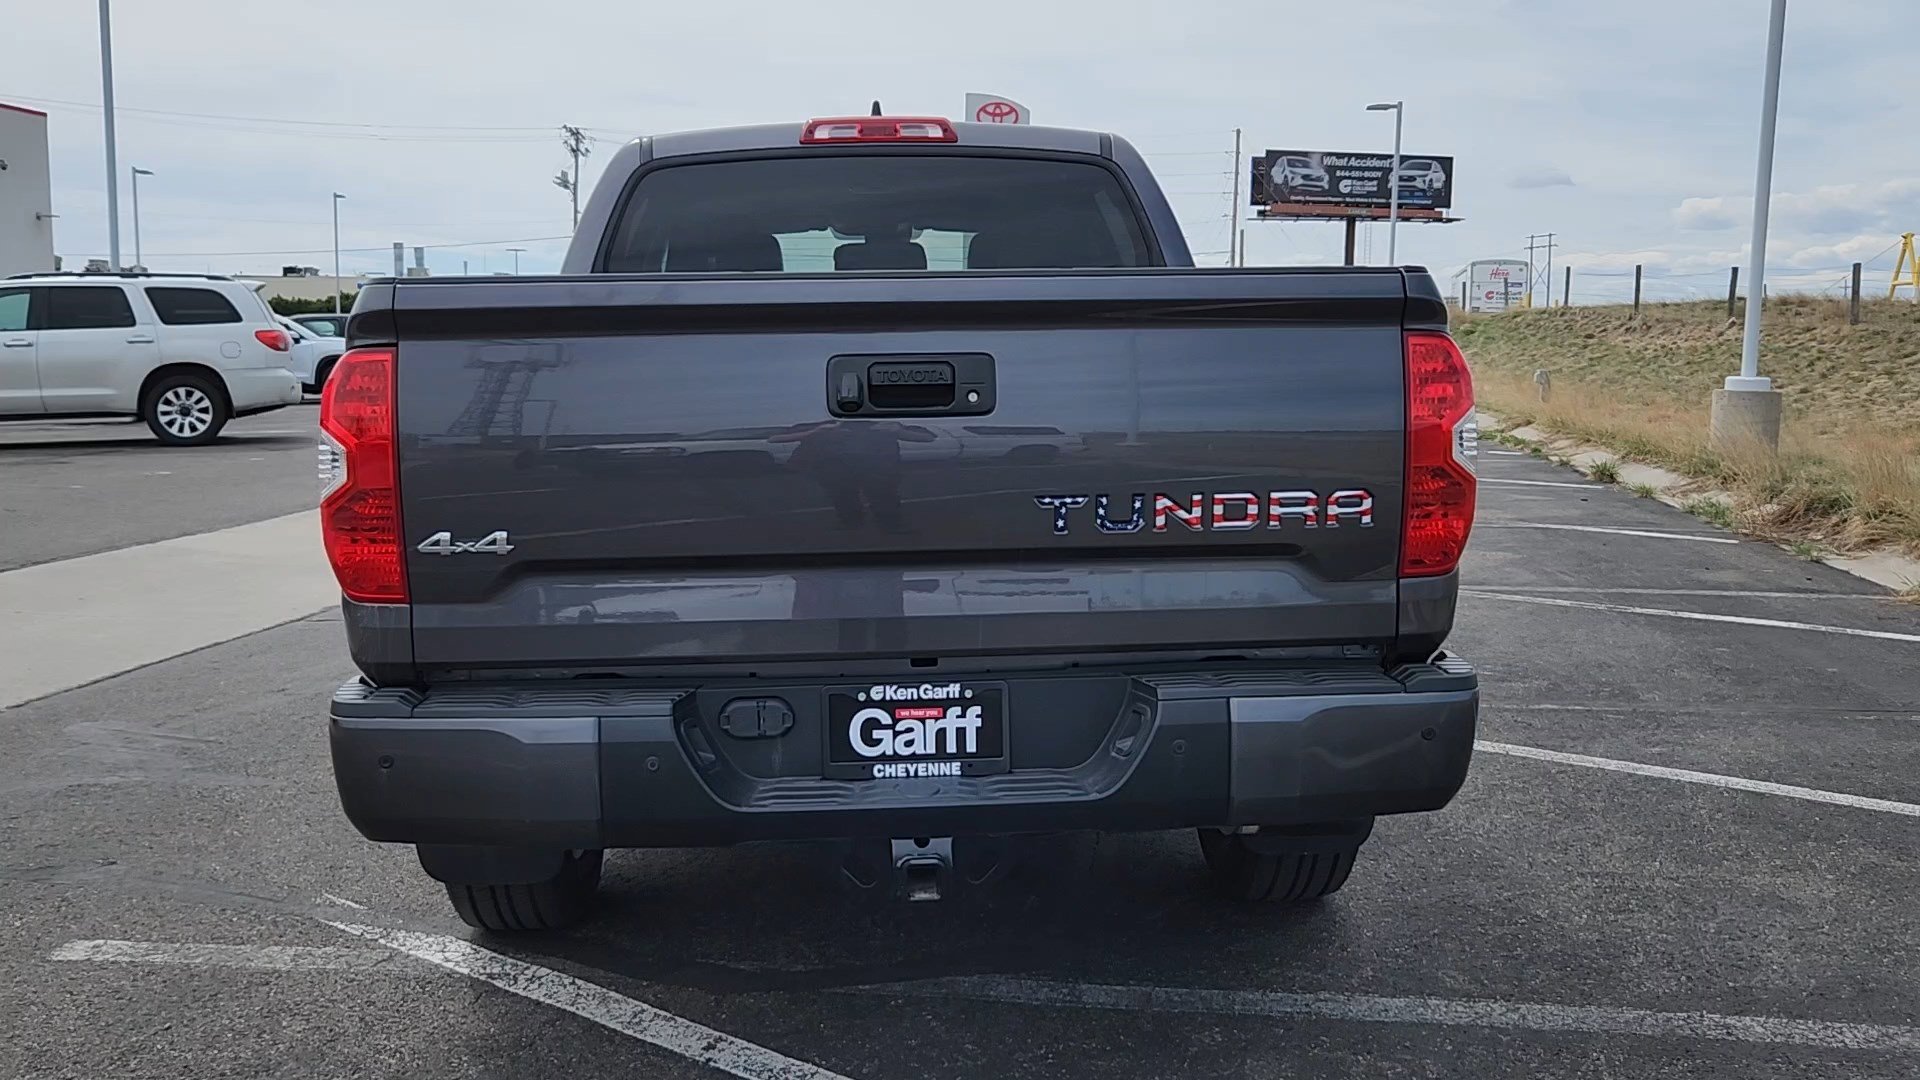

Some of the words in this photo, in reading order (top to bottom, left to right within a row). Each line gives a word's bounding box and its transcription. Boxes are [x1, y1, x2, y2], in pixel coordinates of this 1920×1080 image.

[1322, 155, 1349, 167] What
[876, 368, 949, 384] TOYOTA
[1034, 489, 1375, 535] TUNDRA
[416, 530, 515, 556] 4x4
[885, 684, 918, 700] Ken
[919, 682, 961, 699] Garff
[925, 709, 938, 717] you
[848, 705, 982, 758] Garff
[872, 761, 962, 779] CHEYENNE
